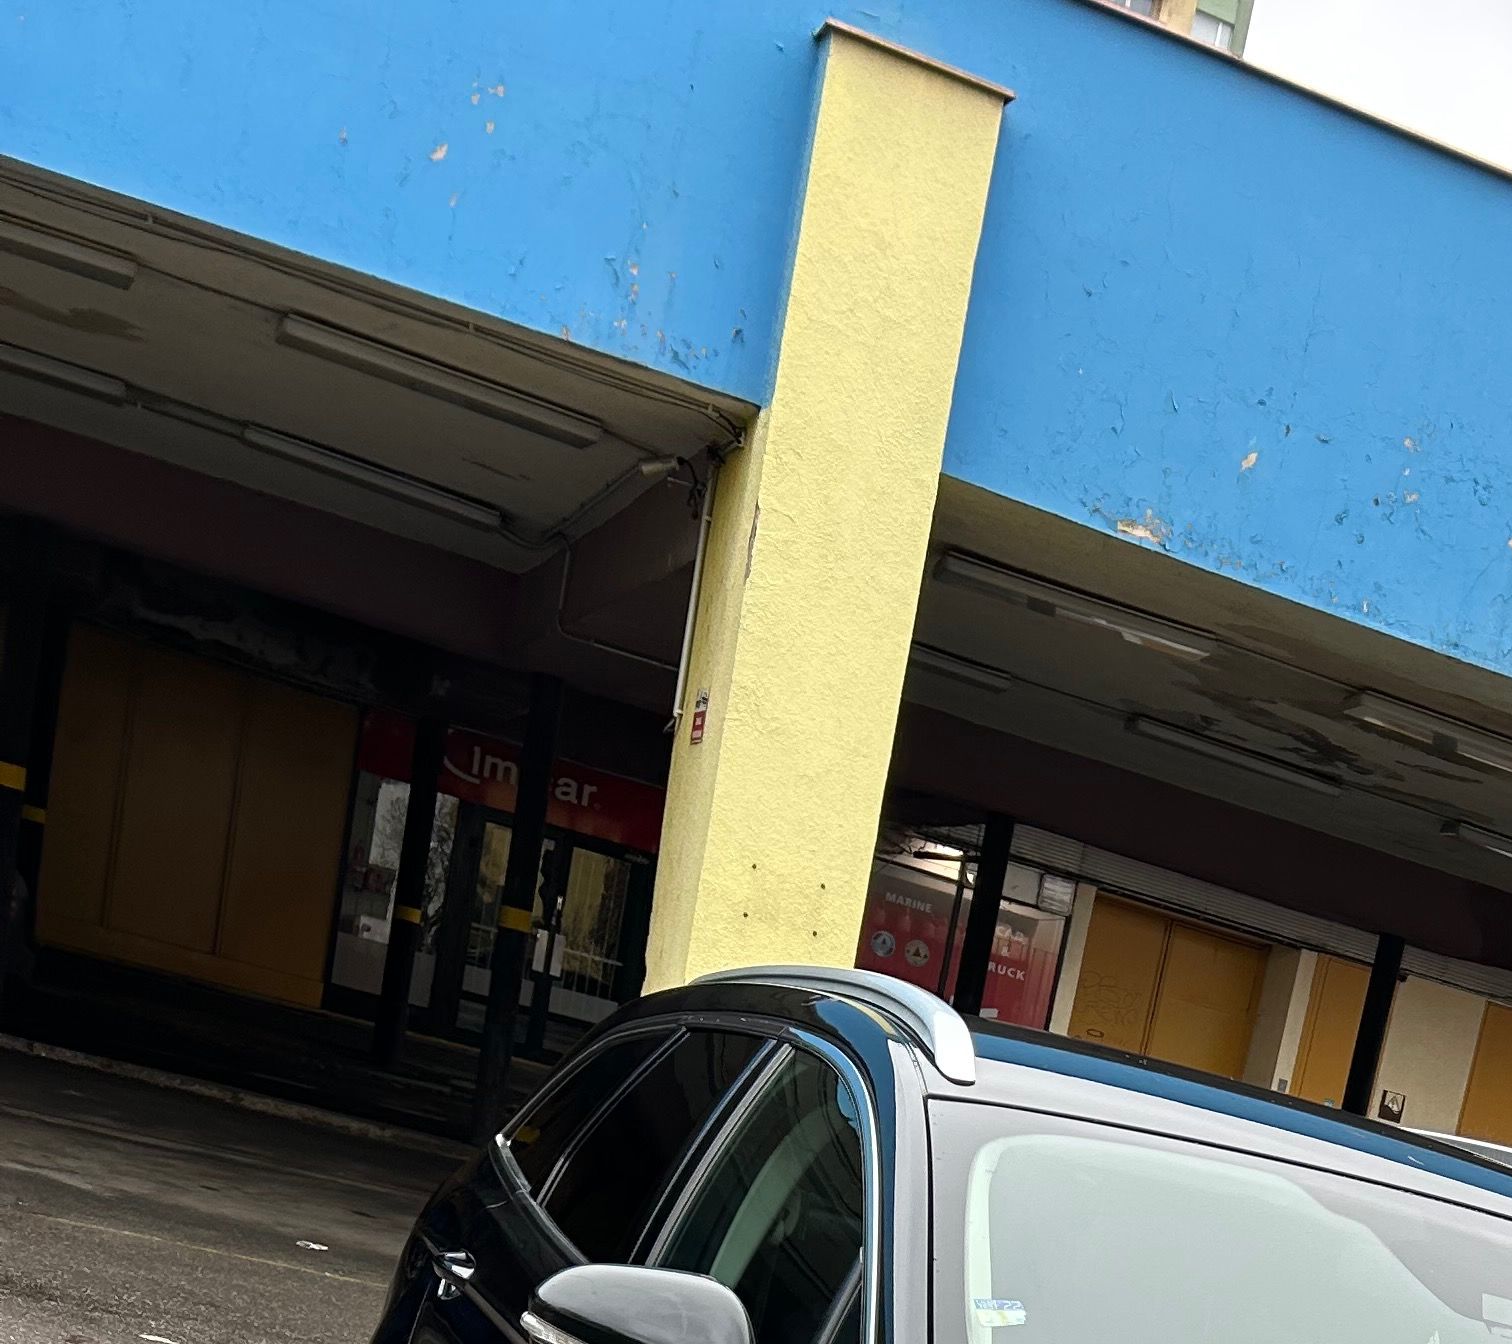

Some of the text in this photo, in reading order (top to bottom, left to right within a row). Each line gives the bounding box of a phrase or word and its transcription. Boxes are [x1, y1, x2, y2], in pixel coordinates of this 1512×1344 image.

[471, 745, 598, 807] Imar
[885, 892, 933, 913] MARINE
[987, 961, 1025, 981] RUCK
